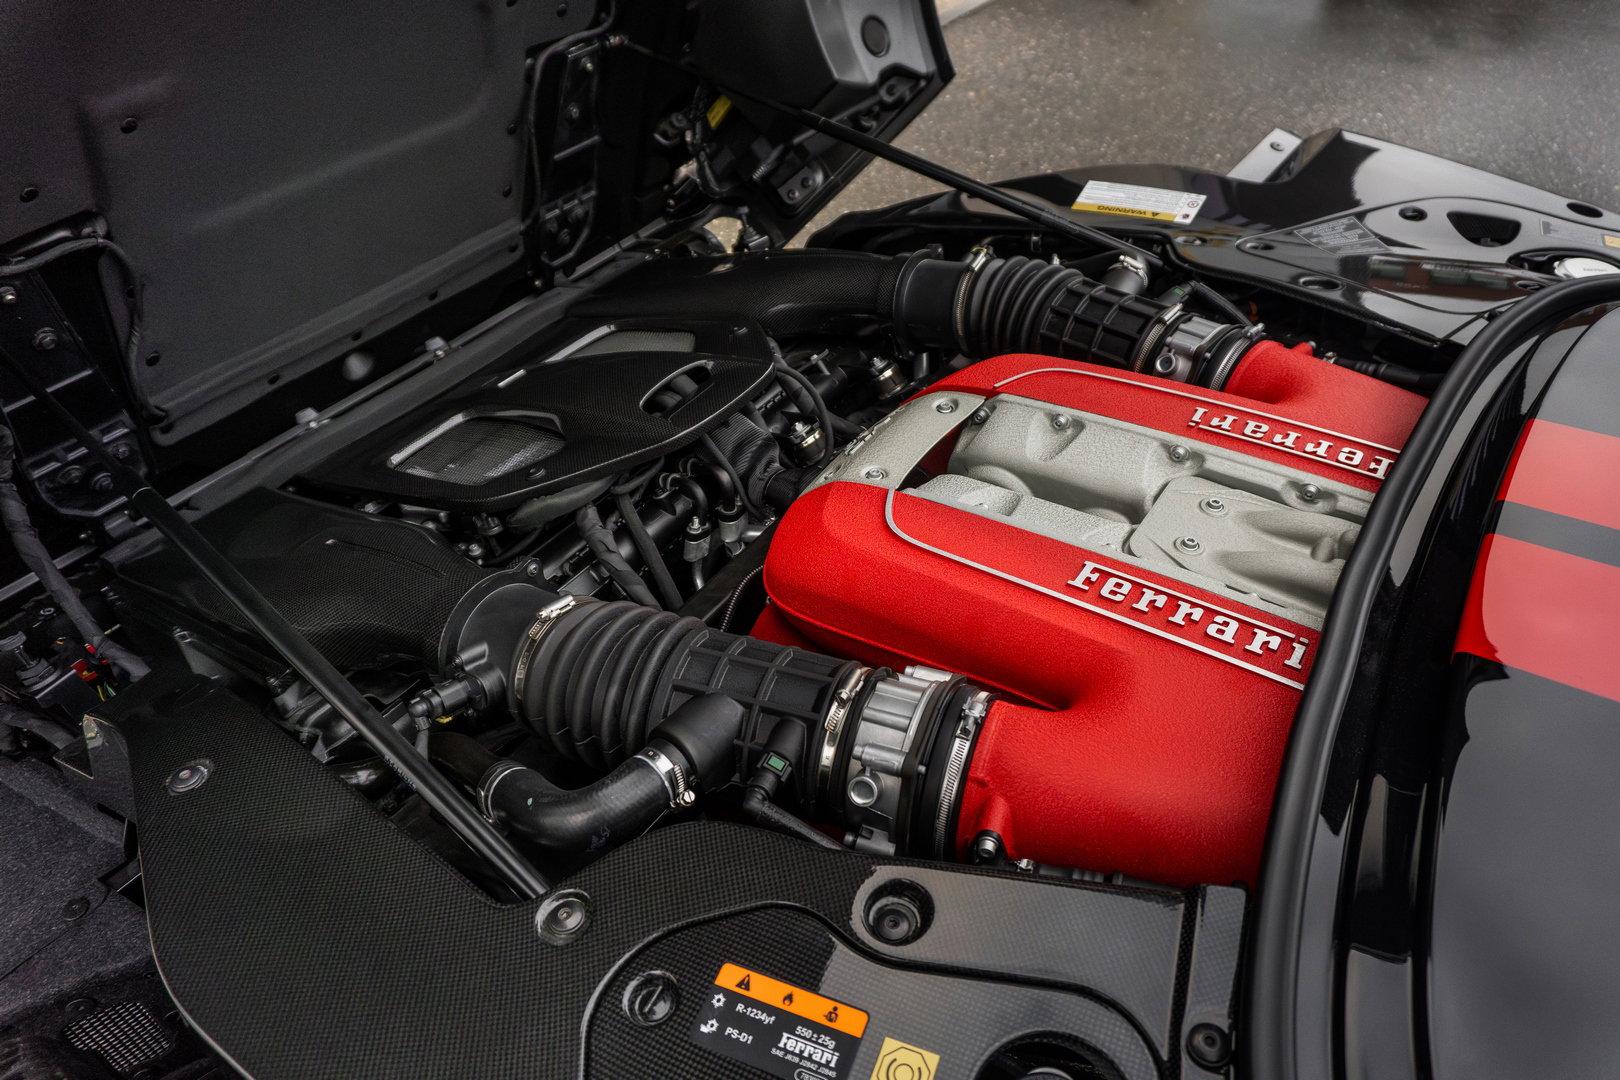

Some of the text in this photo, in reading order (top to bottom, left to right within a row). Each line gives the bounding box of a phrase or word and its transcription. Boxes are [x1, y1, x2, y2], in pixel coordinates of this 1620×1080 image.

[1097, 205, 1147, 215] WARNING
[1187, 407, 1395, 480] Ferrari
[1066, 560, 1310, 670] Ferrari
[735, 1003, 776, 1025] R-1234yf
[724, 1026, 753, 1044] PS-D1
[770, 1048, 785, 1058] SAE
[777, 1032, 840, 1068] Ferrari
